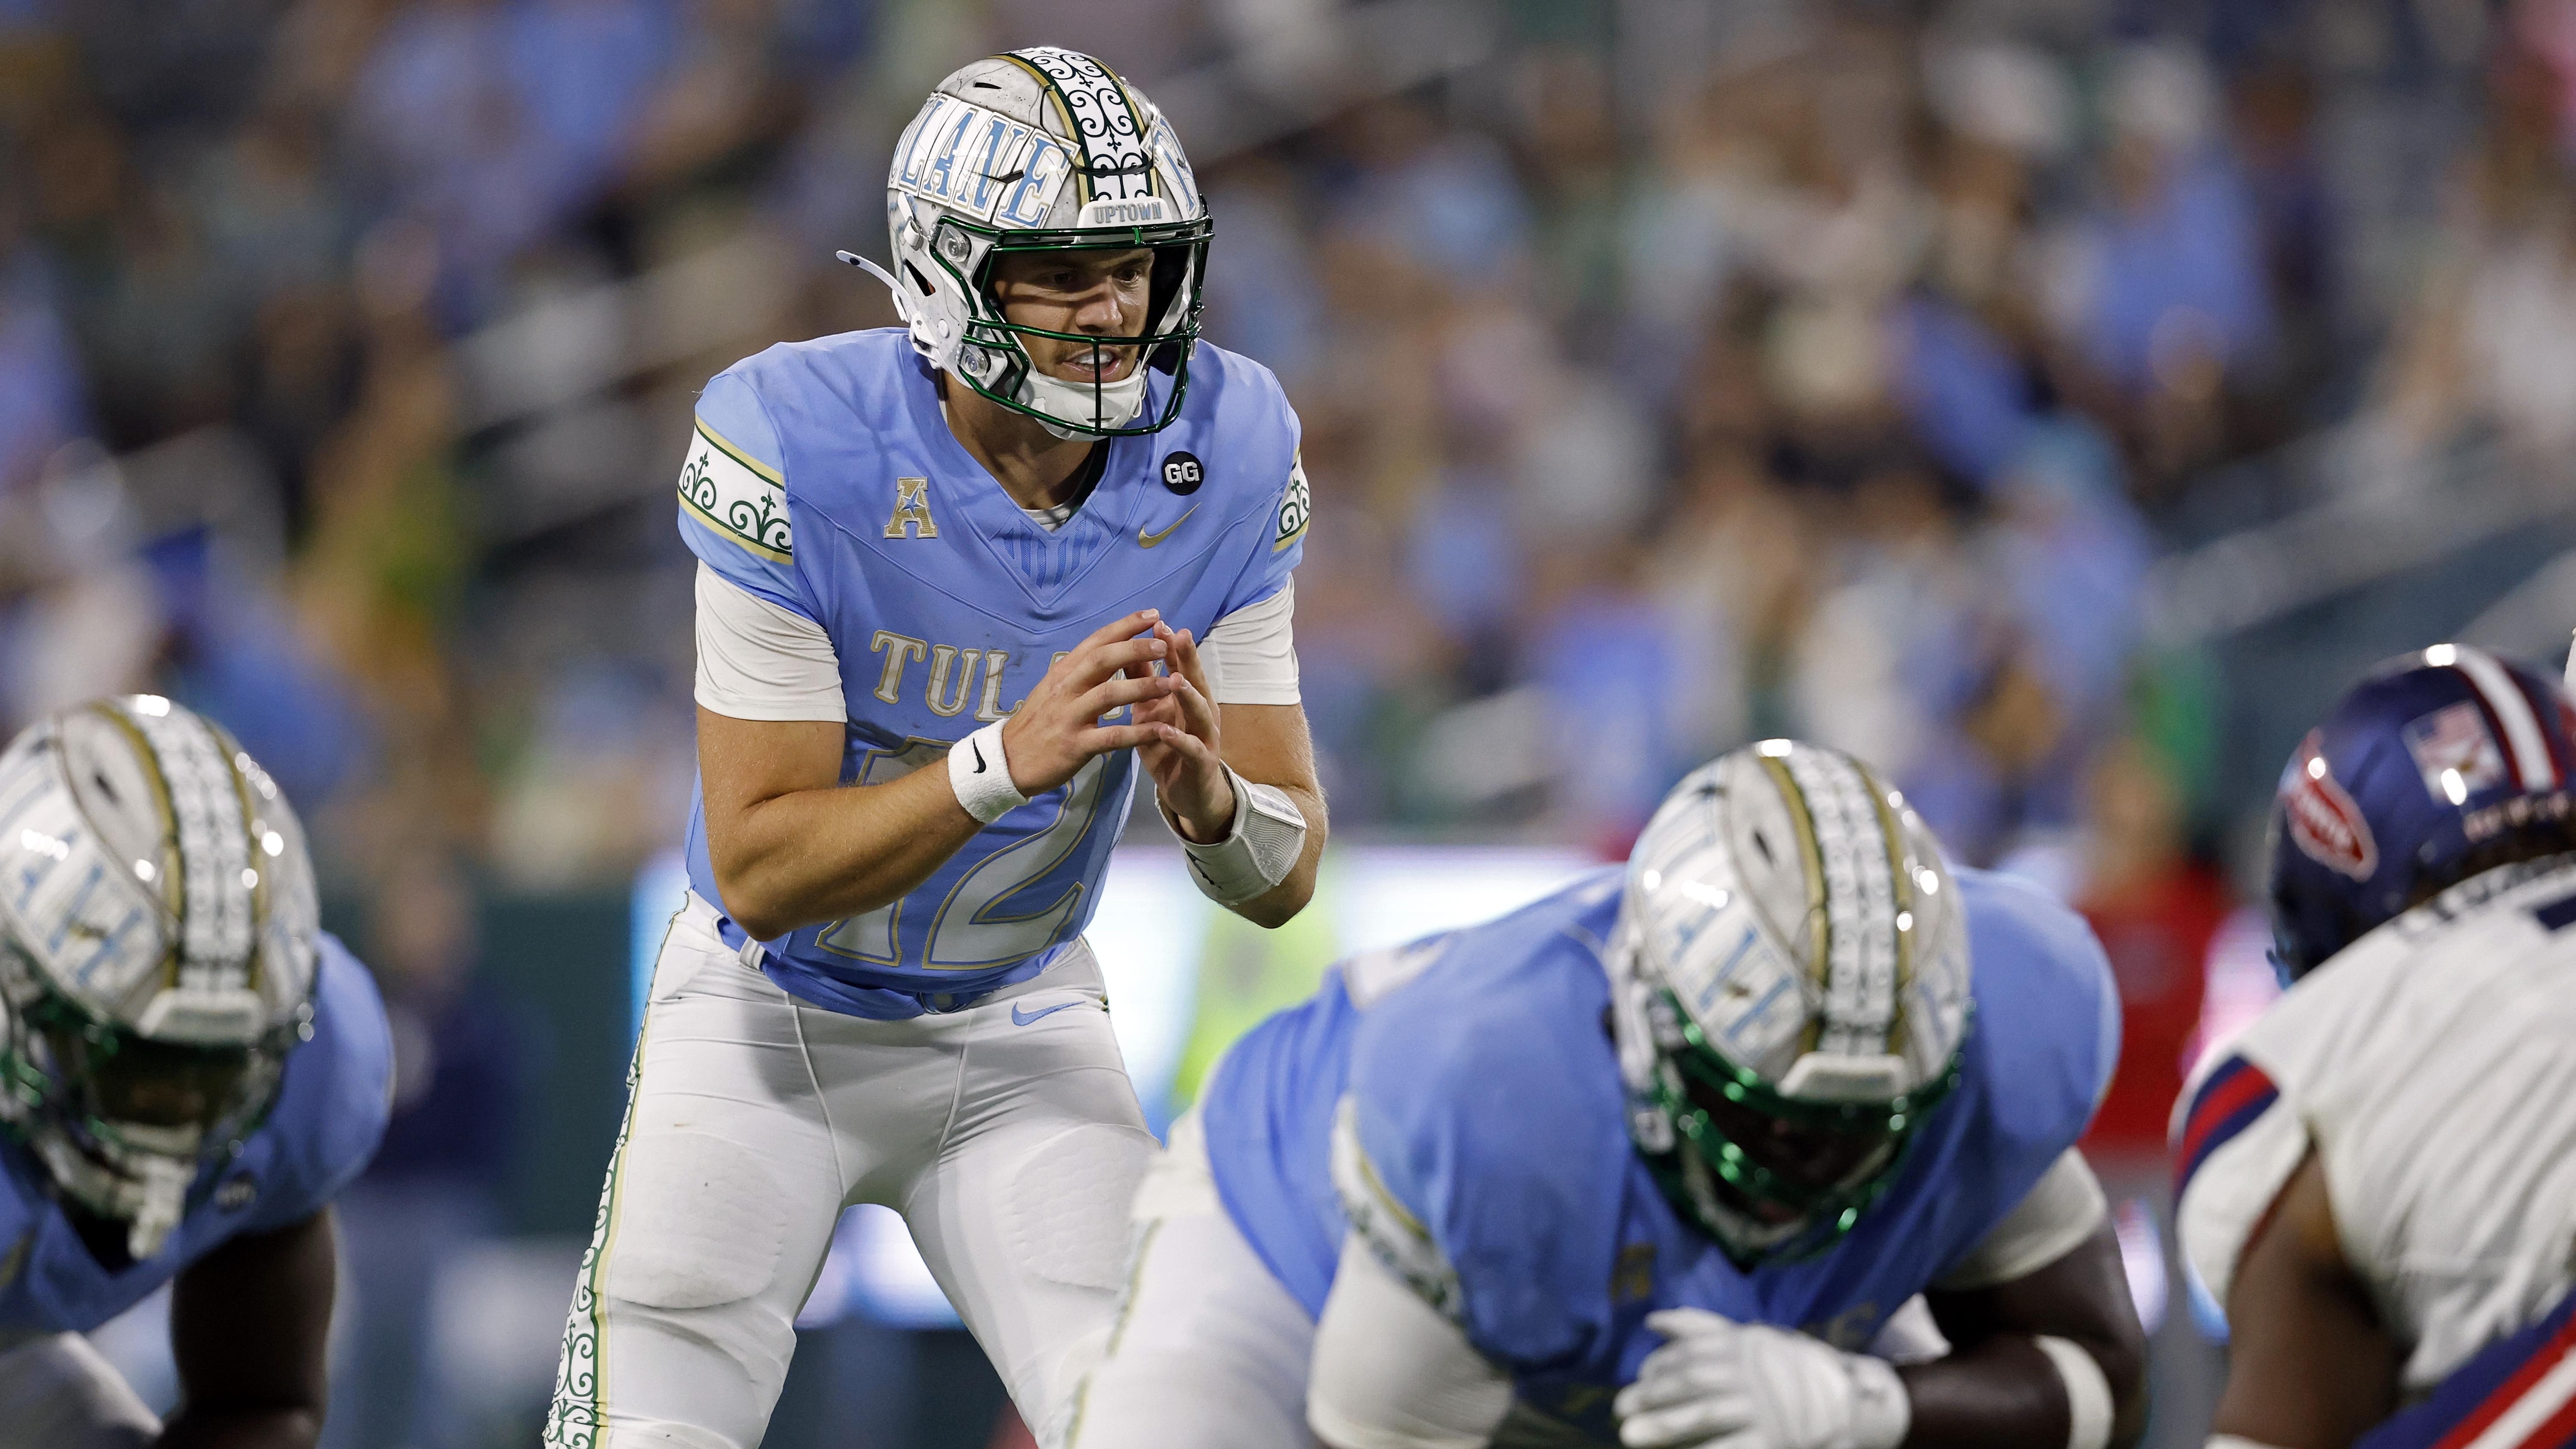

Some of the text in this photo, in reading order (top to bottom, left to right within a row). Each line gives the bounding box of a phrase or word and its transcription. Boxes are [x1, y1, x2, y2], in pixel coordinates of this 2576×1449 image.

[890, 96, 1078, 229] LANE
[1093, 201, 1162, 224] UPTOWN
[1165, 462, 1200, 484] GG
[870, 630, 1163, 722] TUL
